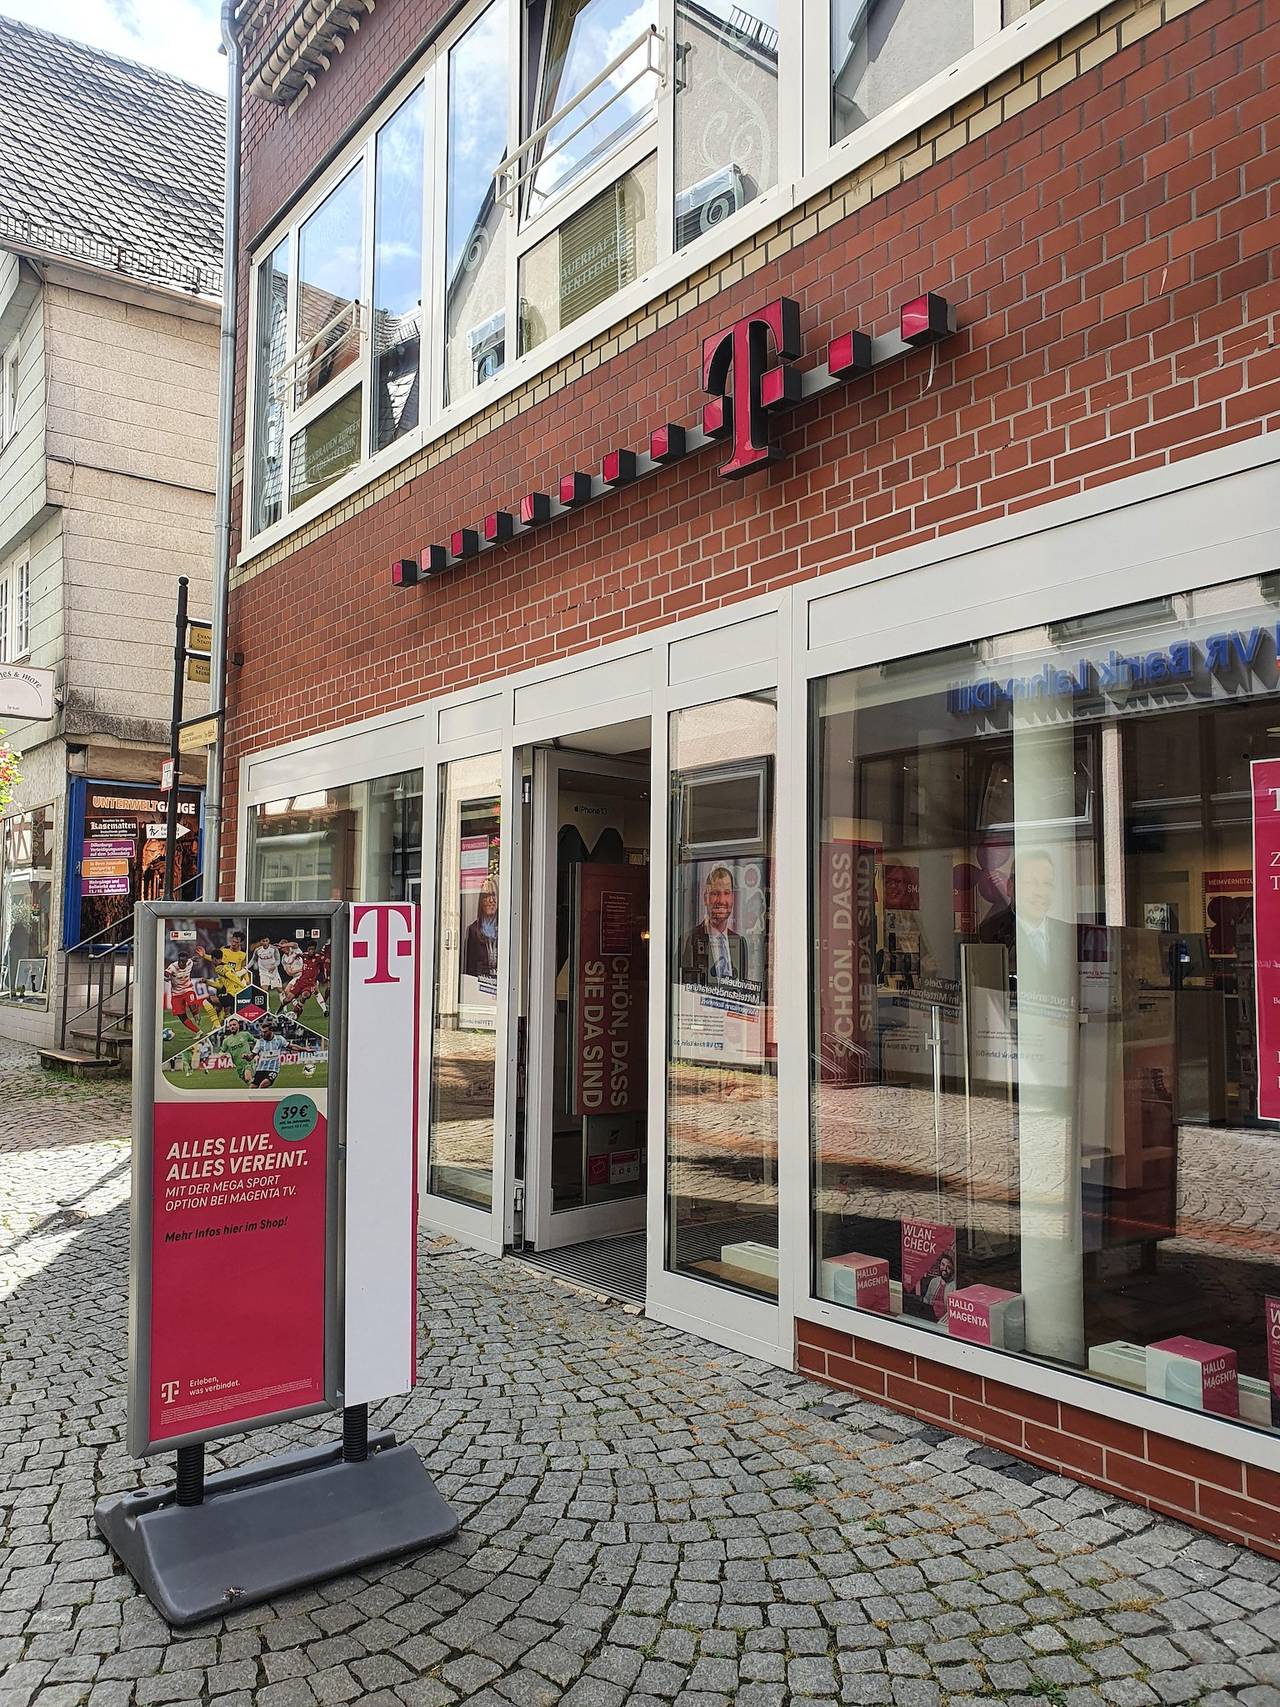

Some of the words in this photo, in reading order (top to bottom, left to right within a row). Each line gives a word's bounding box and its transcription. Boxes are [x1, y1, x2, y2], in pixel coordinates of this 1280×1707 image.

[702, 297, 796, 478] T
[22, 673, 43, 689] more
[831, 852, 852, 930] DASS
[857, 855, 872, 928] SIND
[353, 905, 412, 984] T
[858, 937, 873, 975] DA
[584, 960, 605, 999] SIE
[611, 955, 633, 1036] CHÖN,
[859, 983, 873, 1032] SIE
[584, 1005, 604, 1041] DA
[583, 1046, 604, 1109] SIND
[610, 1040, 630, 1107] DASS
[166, 1138, 226, 1161] ALLES
[229, 1133, 274, 1154] LIVE.
[166, 1158, 226, 1182] ALLES
[230, 1149, 309, 1175] VEREINT.
[165, 1185, 187, 1198] MIT
[188, 1183, 210, 1195] DER
[213, 1179, 244, 1193] MEGA
[246, 1174, 280, 1189] SPORT
[165, 1196, 208, 1212] OPTION
[210, 1195, 227, 1206] BEI
[229, 1188, 280, 1204] MAGENTA
[282, 1185, 297, 1197] TV.
[165, 1230, 193, 1243] Mehr
[195, 1227, 221, 1239] Infos
[223, 1223, 243, 1234] hier
[244, 1222, 257, 1232] im
[260, 1215, 288, 1230] Shop!
[903, 1223, 936, 1240] WLAN-
[903, 1236, 937, 1255] CHECK
[856, 1266, 878, 1280] HALLO
[857, 1274, 888, 1291] MAGENTA
[948, 1297, 974, 1313] HALLO
[949, 1309, 988, 1328] MAGENTA
[1203, 1358, 1226, 1375] HALLO
[1203, 1368, 1237, 1390] MAGENTA
[161, 1380, 180, 1405] T
[189, 1375, 219, 1388] Erleben,
[189, 1387, 204, 1397] was
[204, 1379, 241, 1394] verbindet.
